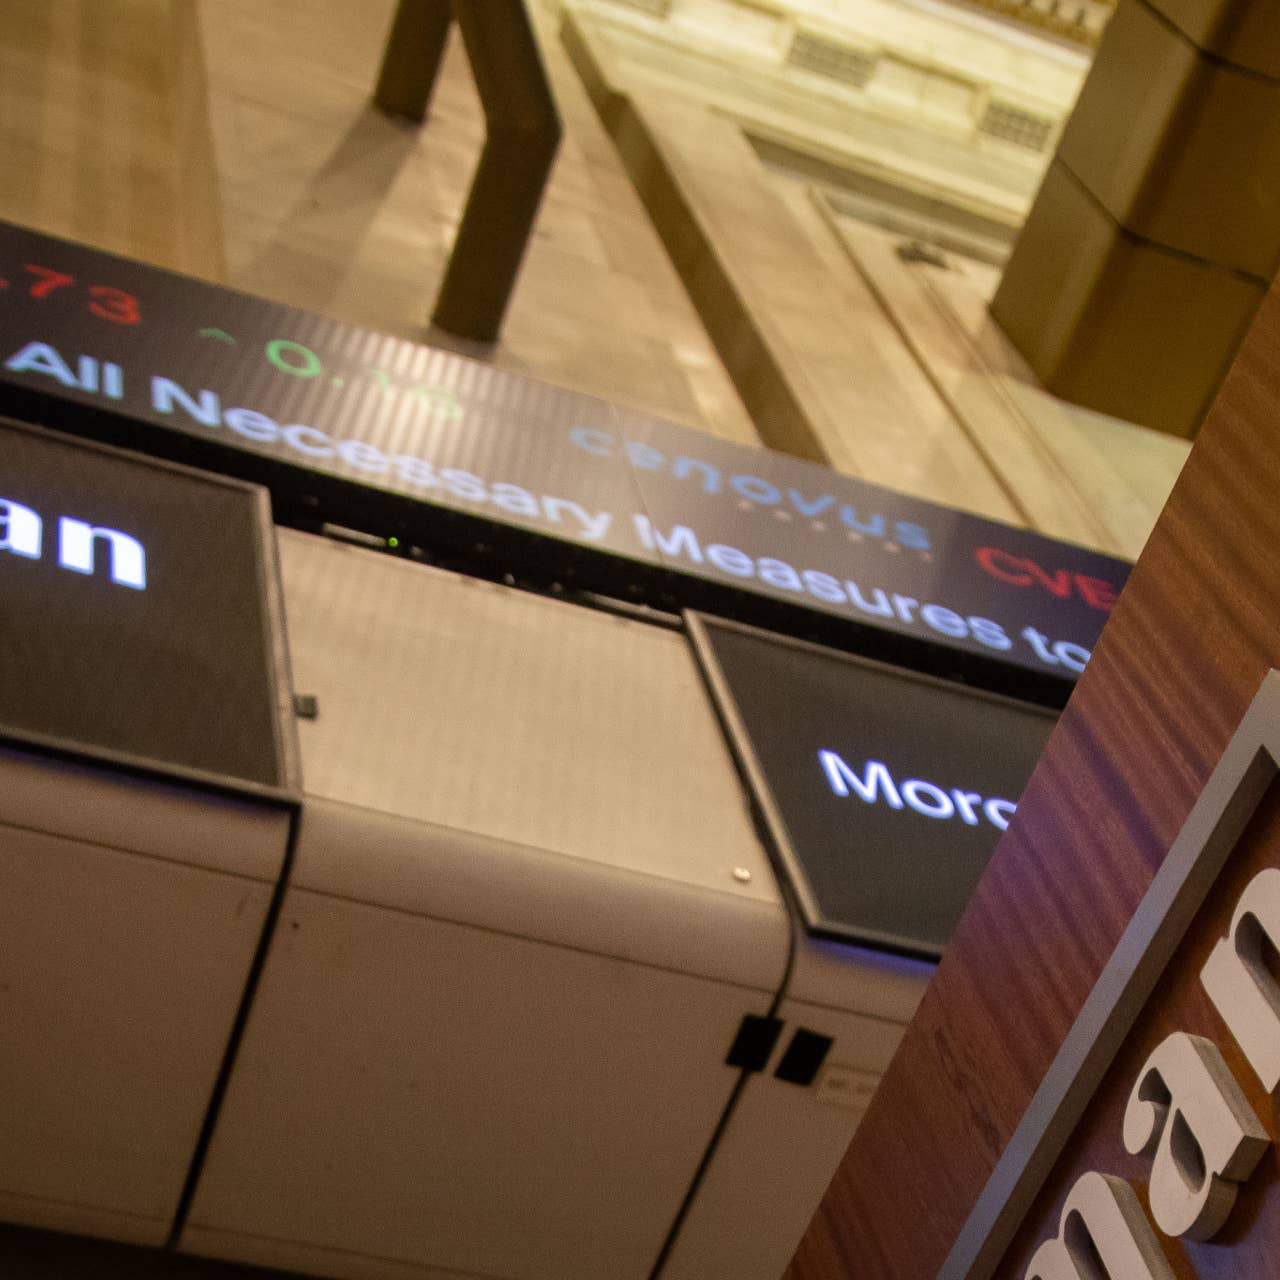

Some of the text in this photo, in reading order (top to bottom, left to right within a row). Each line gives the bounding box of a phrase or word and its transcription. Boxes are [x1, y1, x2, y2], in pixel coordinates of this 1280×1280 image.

[4, 341, 123, 400] All
[150, 376, 611, 541] Necessary
[634, 513, 1013, 651] Measures
[1022, 626, 1091, 672] to
[568, 426, 932, 549] cenovus
